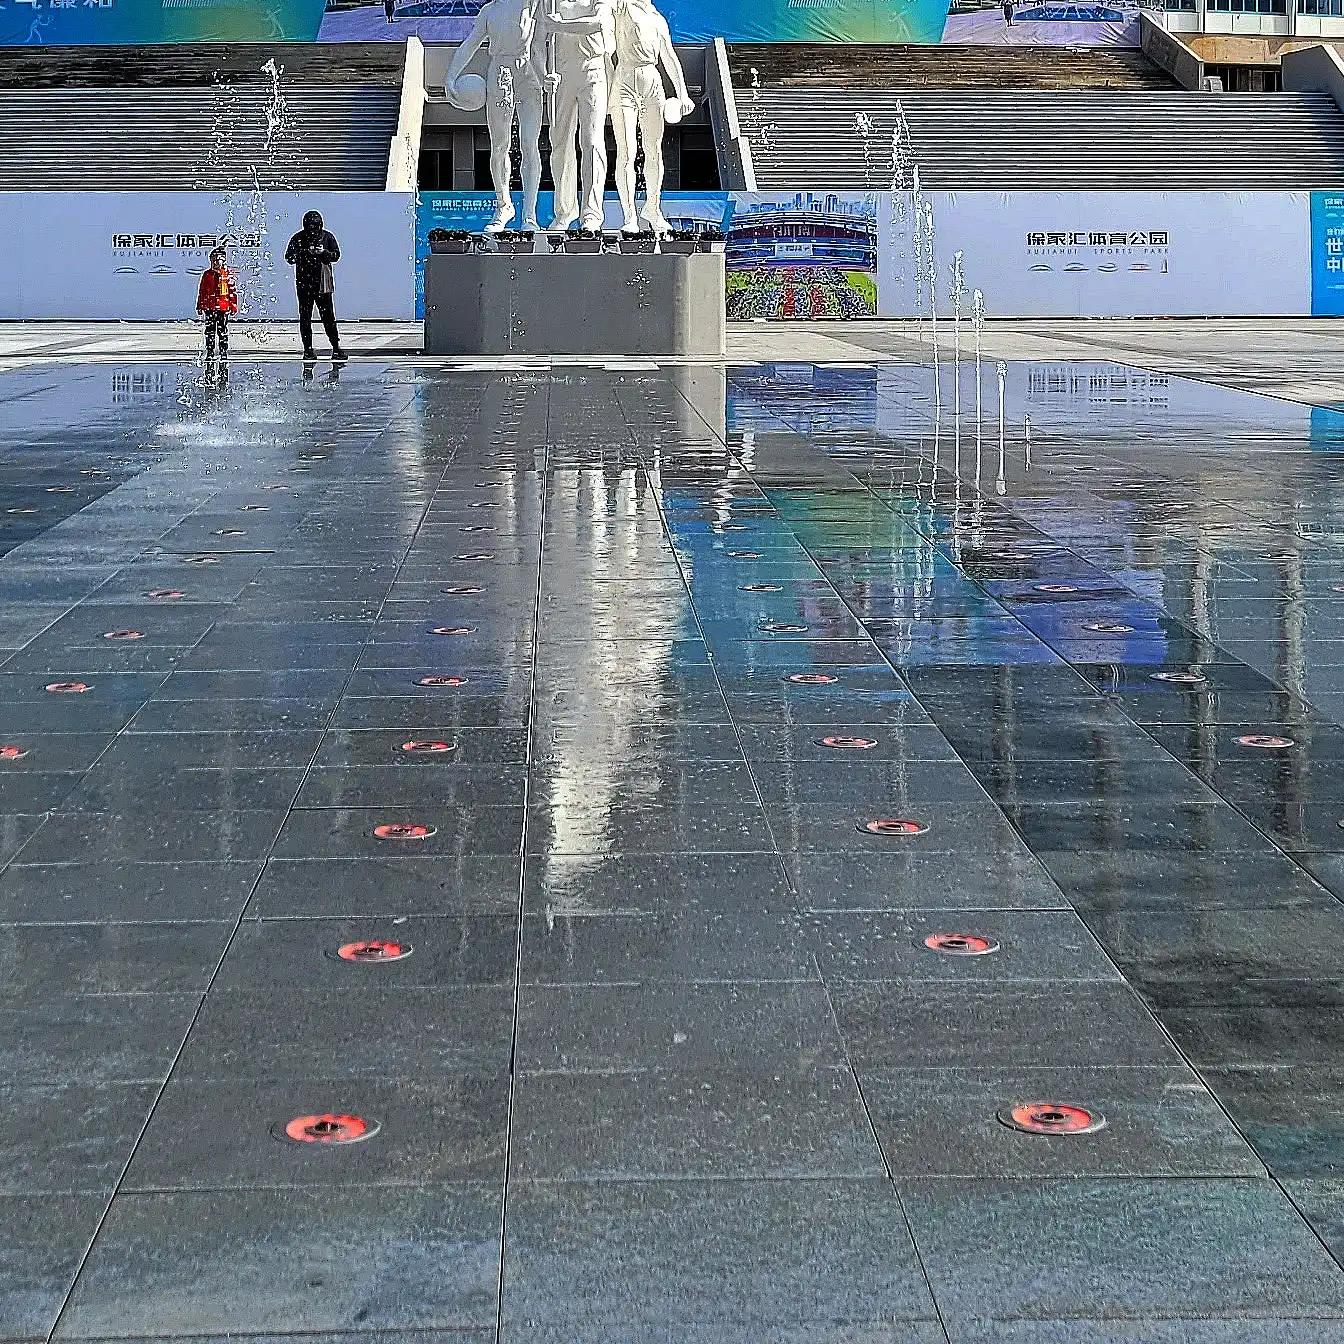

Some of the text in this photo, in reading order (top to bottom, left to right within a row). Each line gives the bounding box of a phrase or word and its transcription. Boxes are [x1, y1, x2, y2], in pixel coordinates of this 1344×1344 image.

[1027, 232, 1168, 246] 徐家汇体育公园
